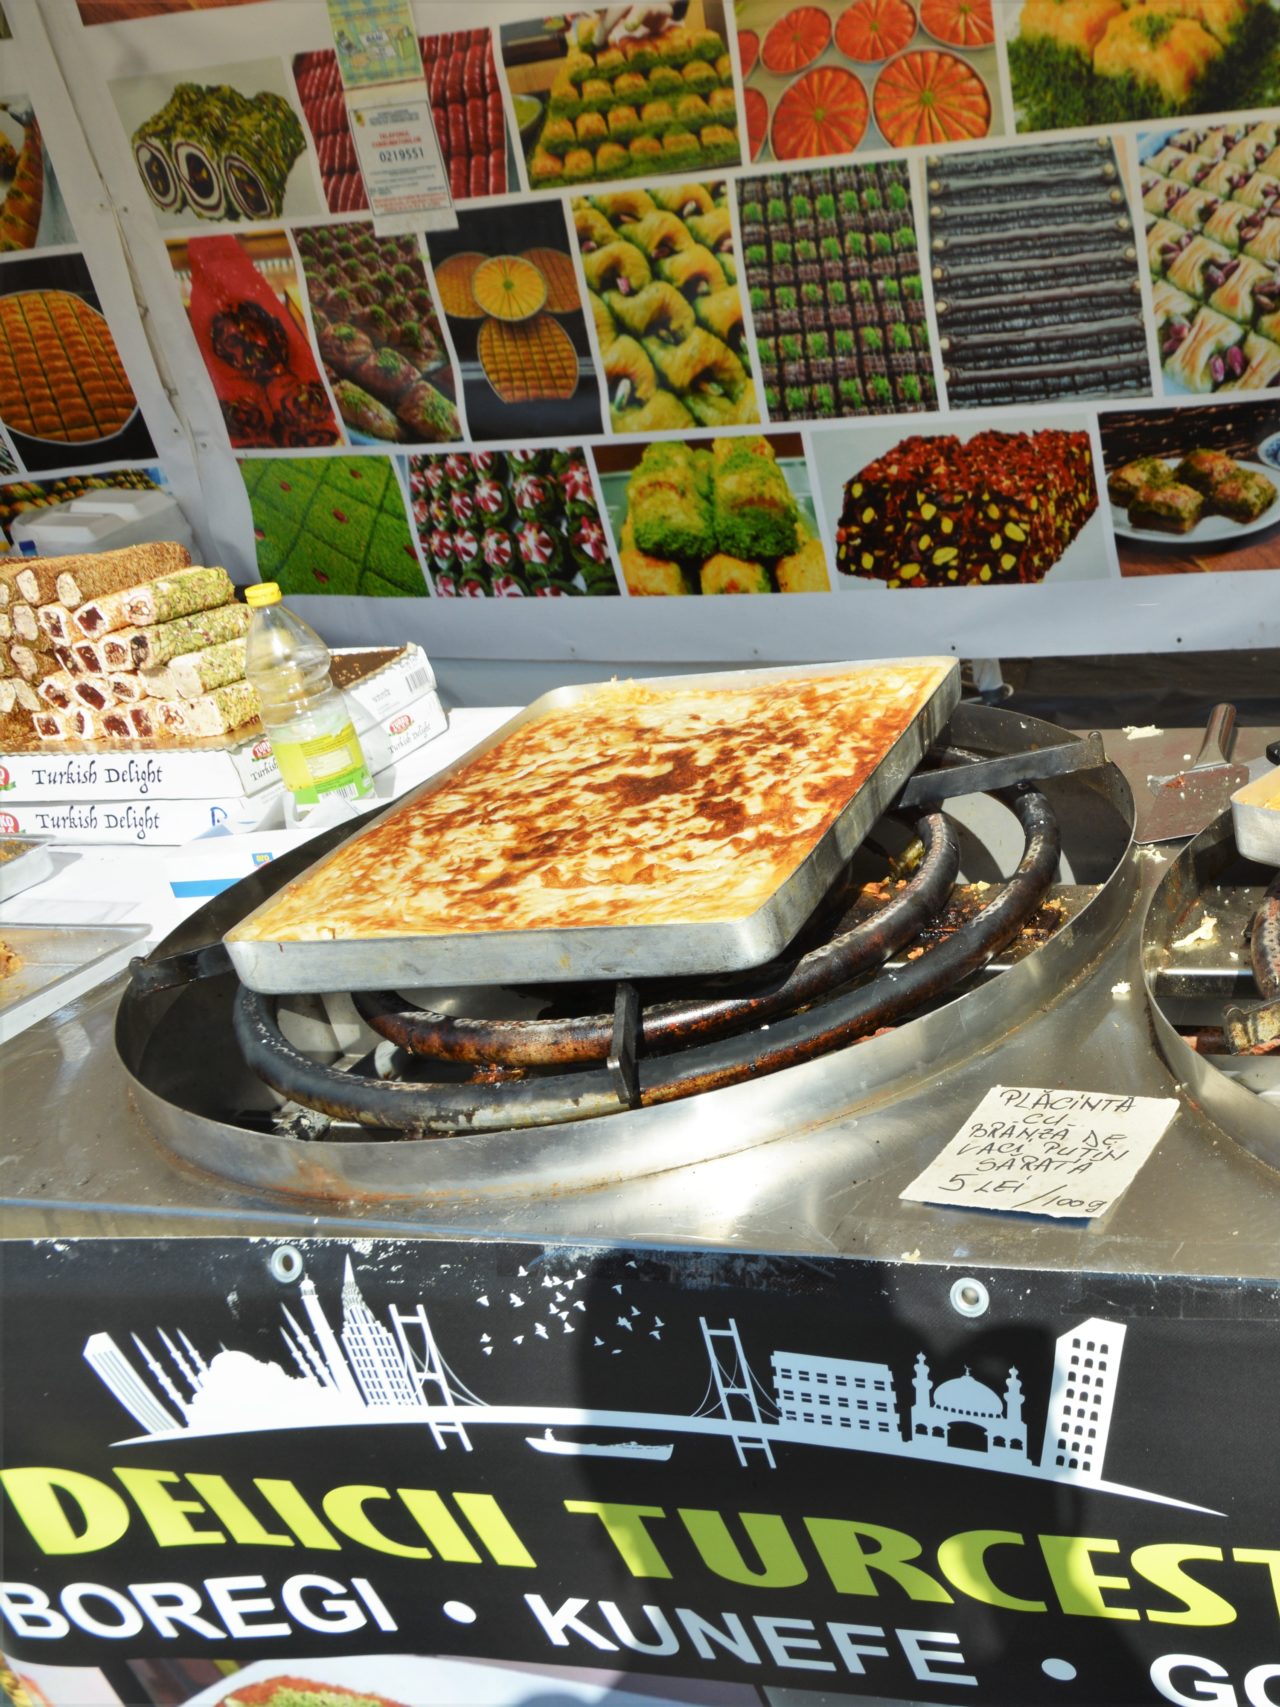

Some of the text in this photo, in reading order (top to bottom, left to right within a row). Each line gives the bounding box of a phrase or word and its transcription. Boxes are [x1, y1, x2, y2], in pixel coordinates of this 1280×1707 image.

[380, 147, 424, 162] 0219551
[32, 759, 163, 794] Turkish Delight
[35, 805, 160, 840] Turkish Delight
[1082, 1129, 1128, 1148] DE
[938, 1173, 979, 1191] 5
[974, 1175, 1034, 1193] LEI
[0, 1466, 537, 1568] DELICII
[0, 1574, 398, 1639] BOREGI
[524, 1593, 979, 1687] KUNEFE
